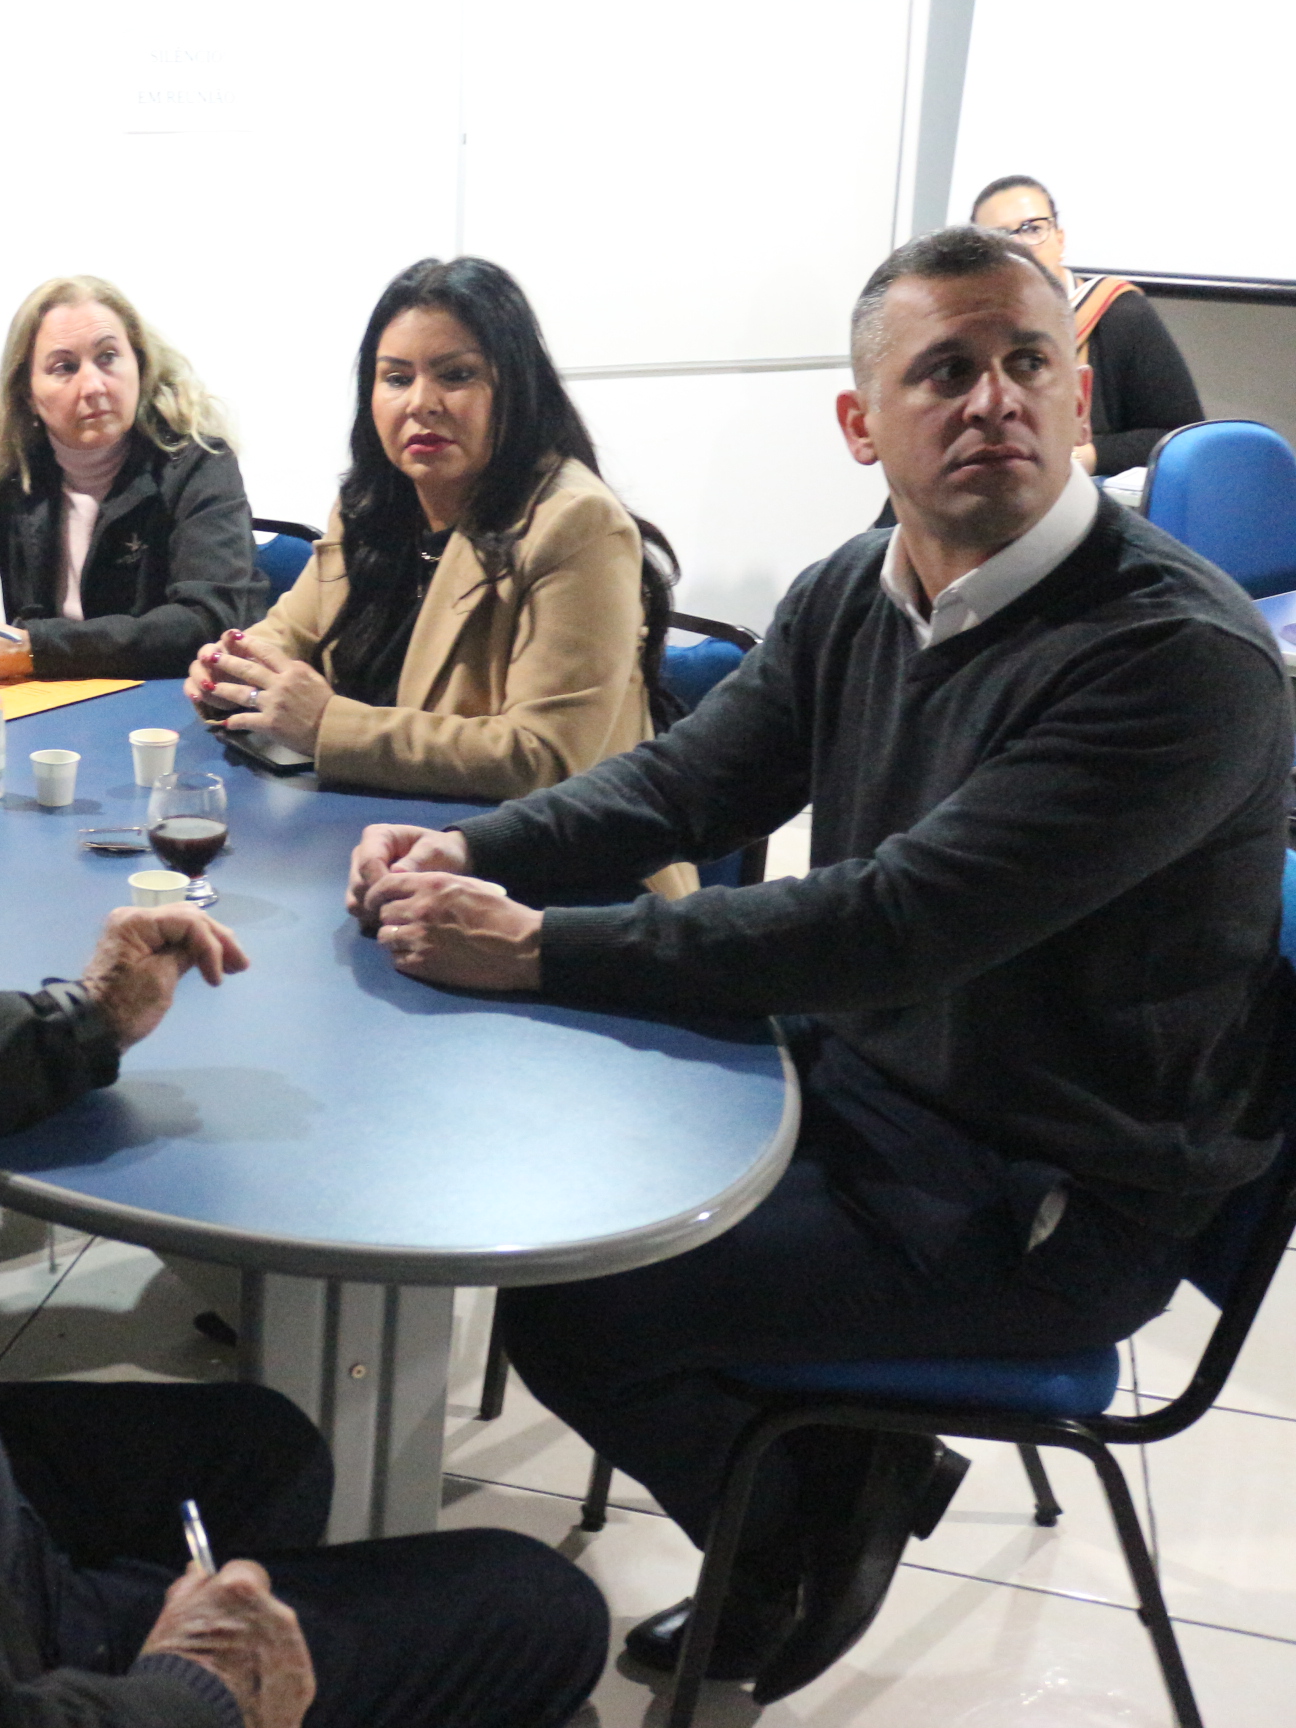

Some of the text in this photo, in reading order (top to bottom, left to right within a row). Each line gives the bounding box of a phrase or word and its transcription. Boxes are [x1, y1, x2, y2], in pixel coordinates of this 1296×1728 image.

[150, 46, 223, 63] SILÊNCIO
[137, 88, 236, 104] EM REUNIÃO
